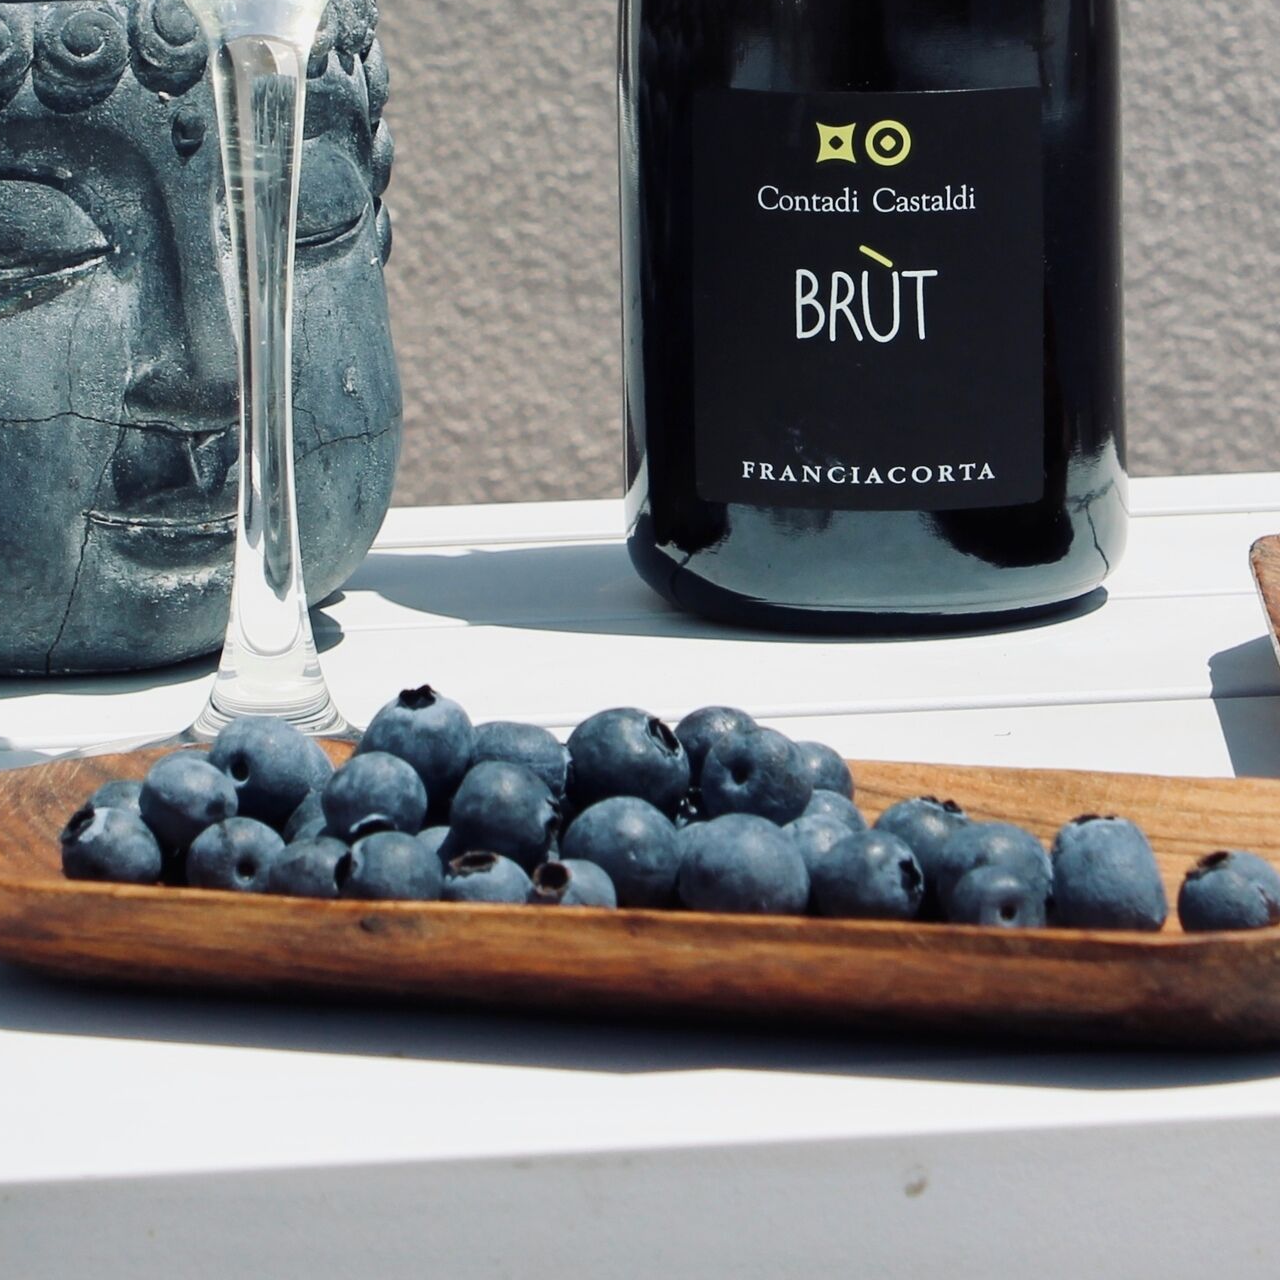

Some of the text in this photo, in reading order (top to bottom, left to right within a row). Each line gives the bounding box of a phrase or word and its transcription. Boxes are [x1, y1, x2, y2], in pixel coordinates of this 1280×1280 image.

[757, 184, 976, 213] Contadi Castaldi
[742, 460, 996, 485] FRANCIACORTA
